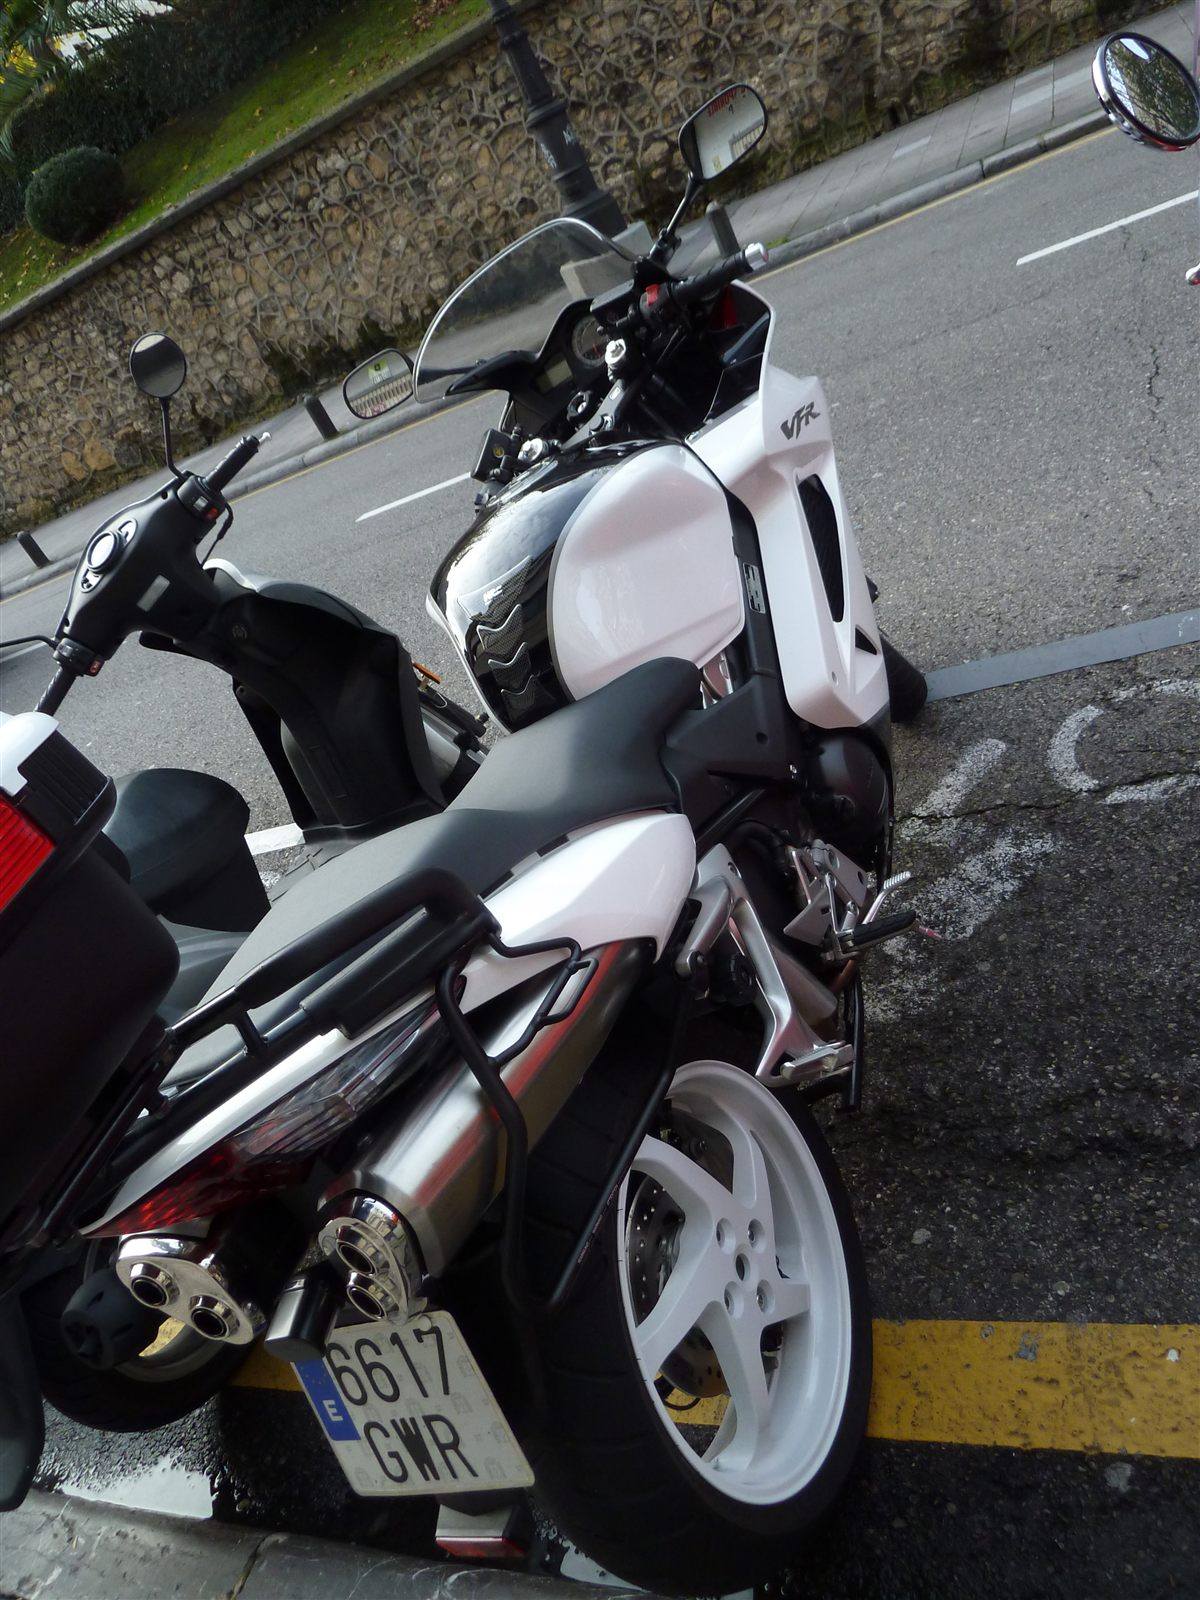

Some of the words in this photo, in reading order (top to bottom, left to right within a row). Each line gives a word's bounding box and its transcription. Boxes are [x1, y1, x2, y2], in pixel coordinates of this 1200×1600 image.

[780, 401, 821, 441] VFR
[325, 1326, 450, 1406] 6617
[323, 1399, 344, 1422] E
[363, 1413, 479, 1484] GWR
